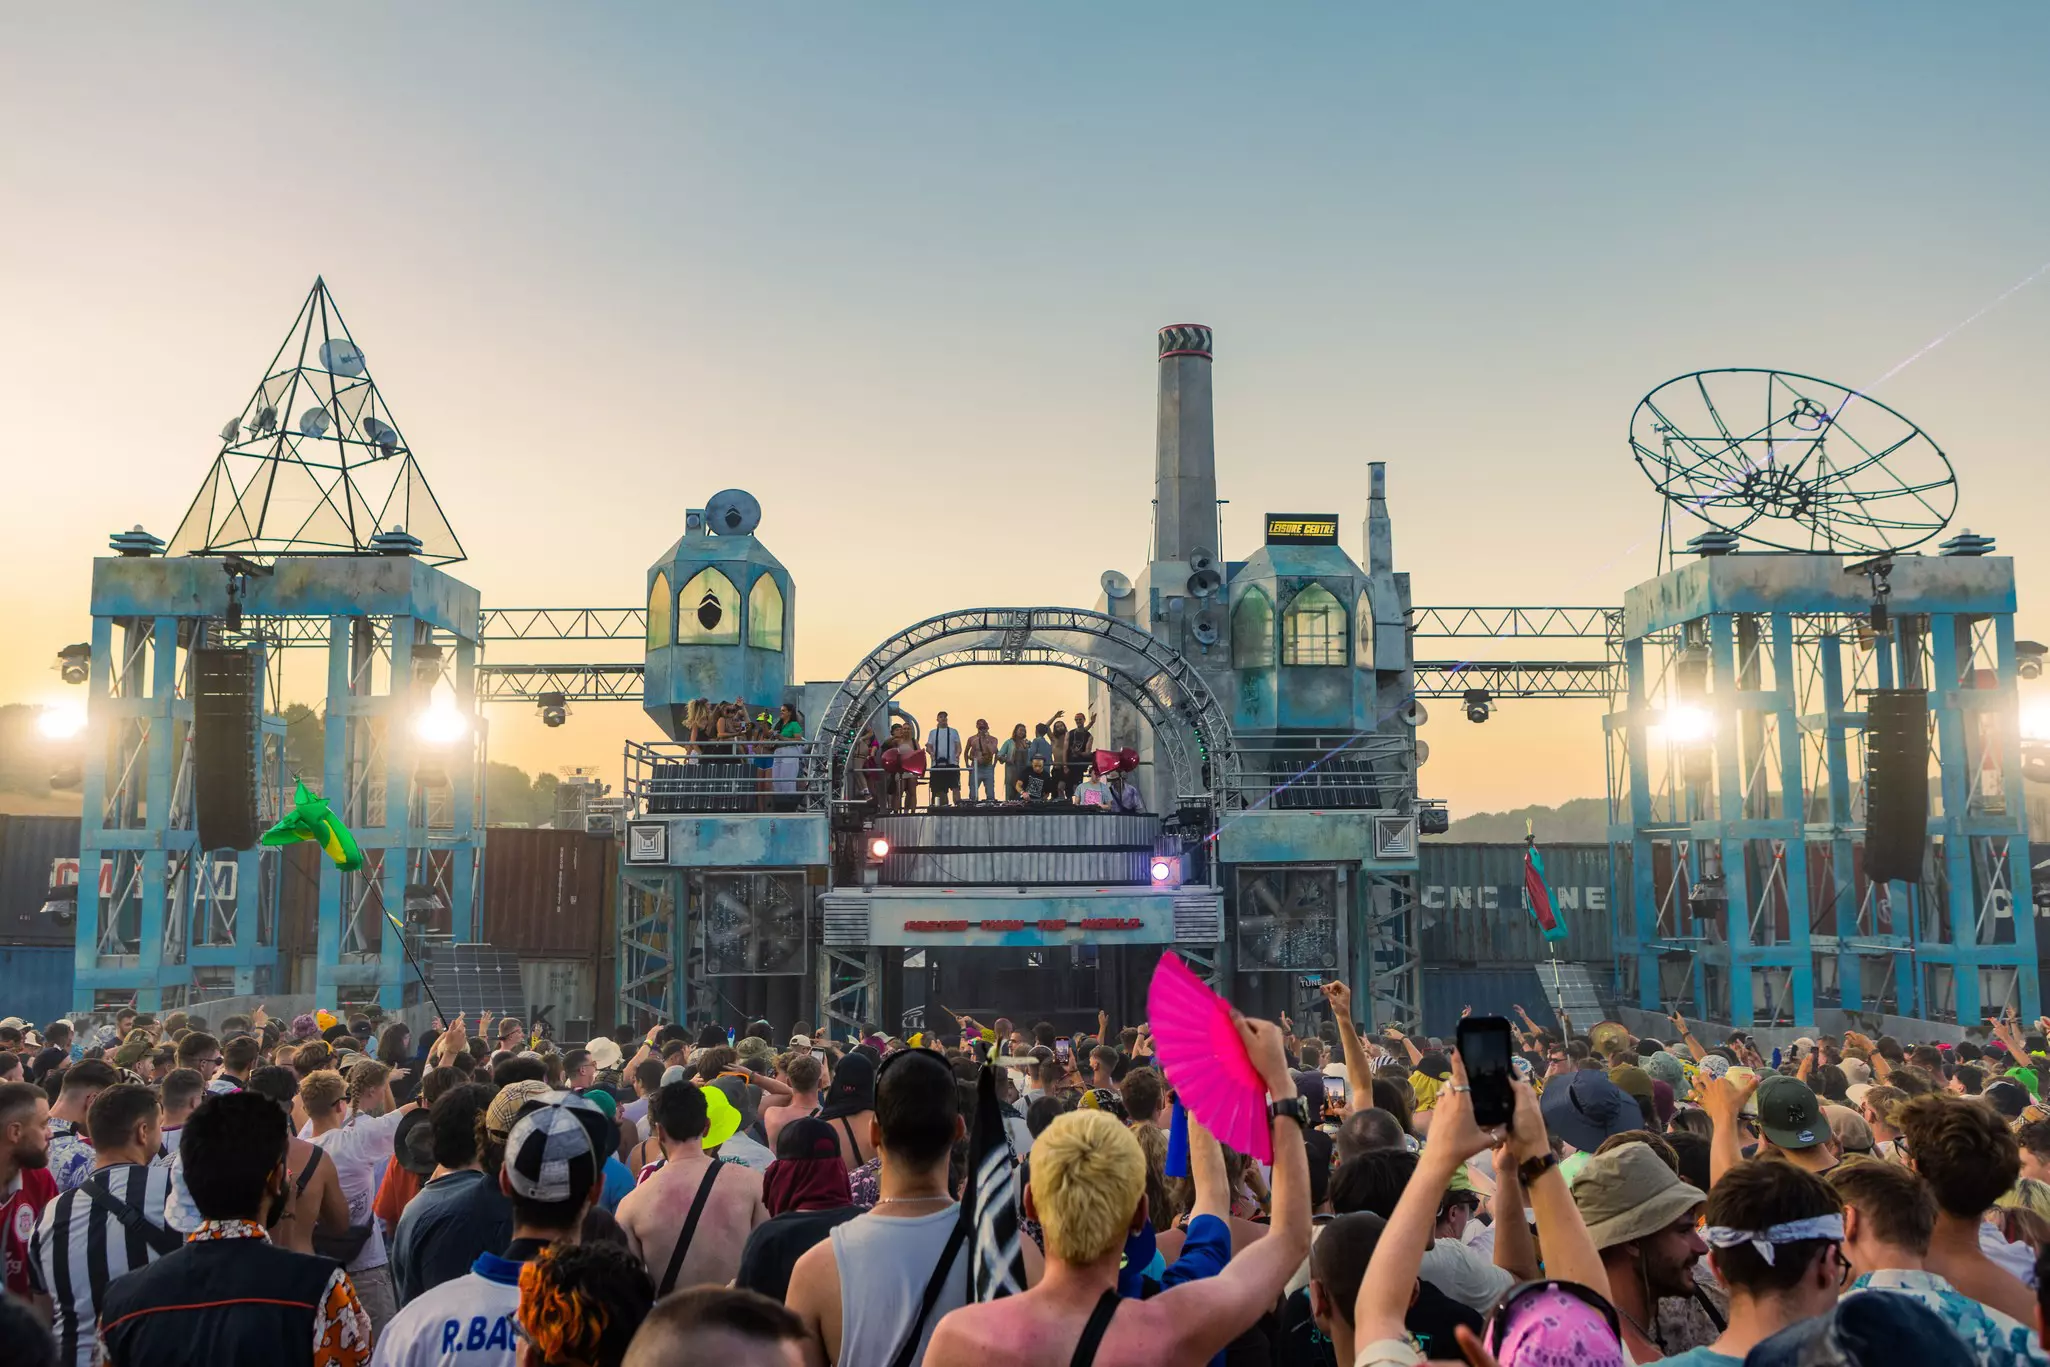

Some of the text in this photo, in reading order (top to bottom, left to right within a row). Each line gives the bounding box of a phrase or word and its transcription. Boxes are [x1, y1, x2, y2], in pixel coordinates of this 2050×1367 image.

[1268, 523, 1336, 534] LEISURE CENTRE
[1424, 885, 1499, 909] CNC
[1080, 917, 1140, 930] WORLD
